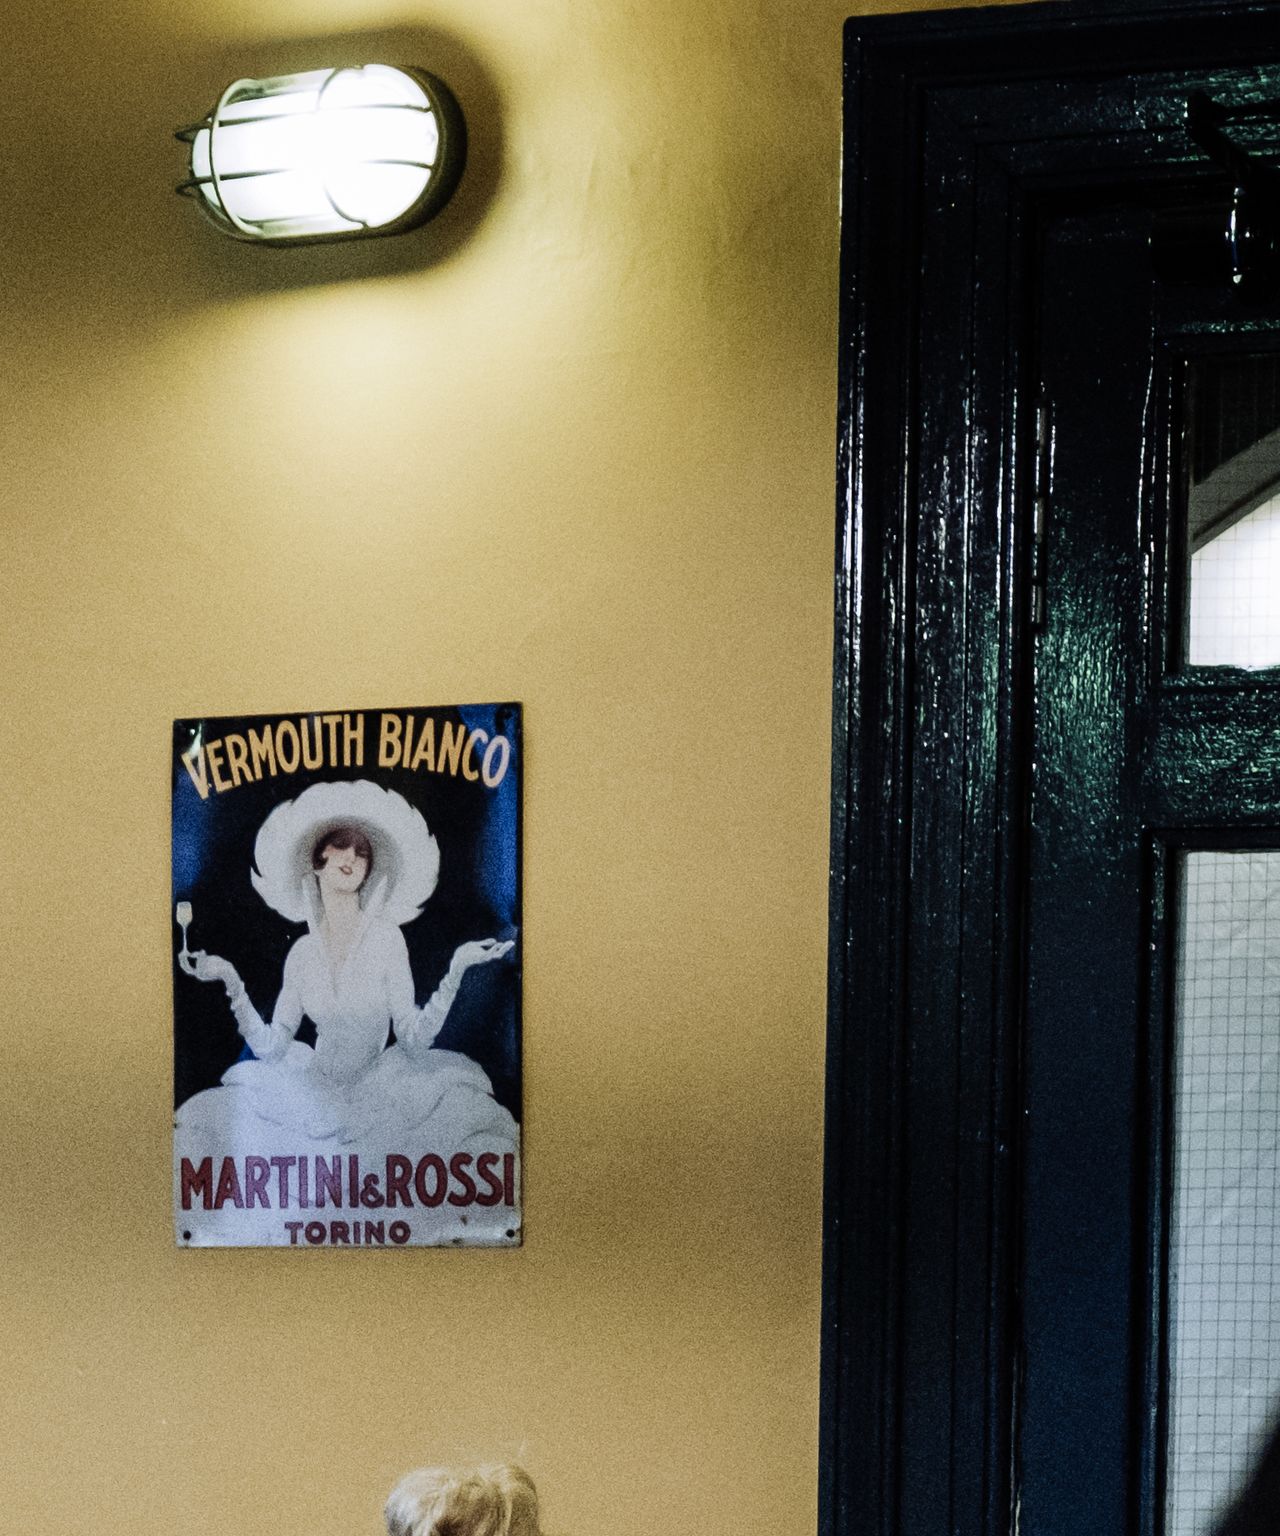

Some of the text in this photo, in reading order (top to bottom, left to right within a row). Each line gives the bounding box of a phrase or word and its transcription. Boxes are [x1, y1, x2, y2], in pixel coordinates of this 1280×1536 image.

[182, 713, 511, 800] VERMOUTH BIANCO
[284, 1220, 412, 1245] TORINO
